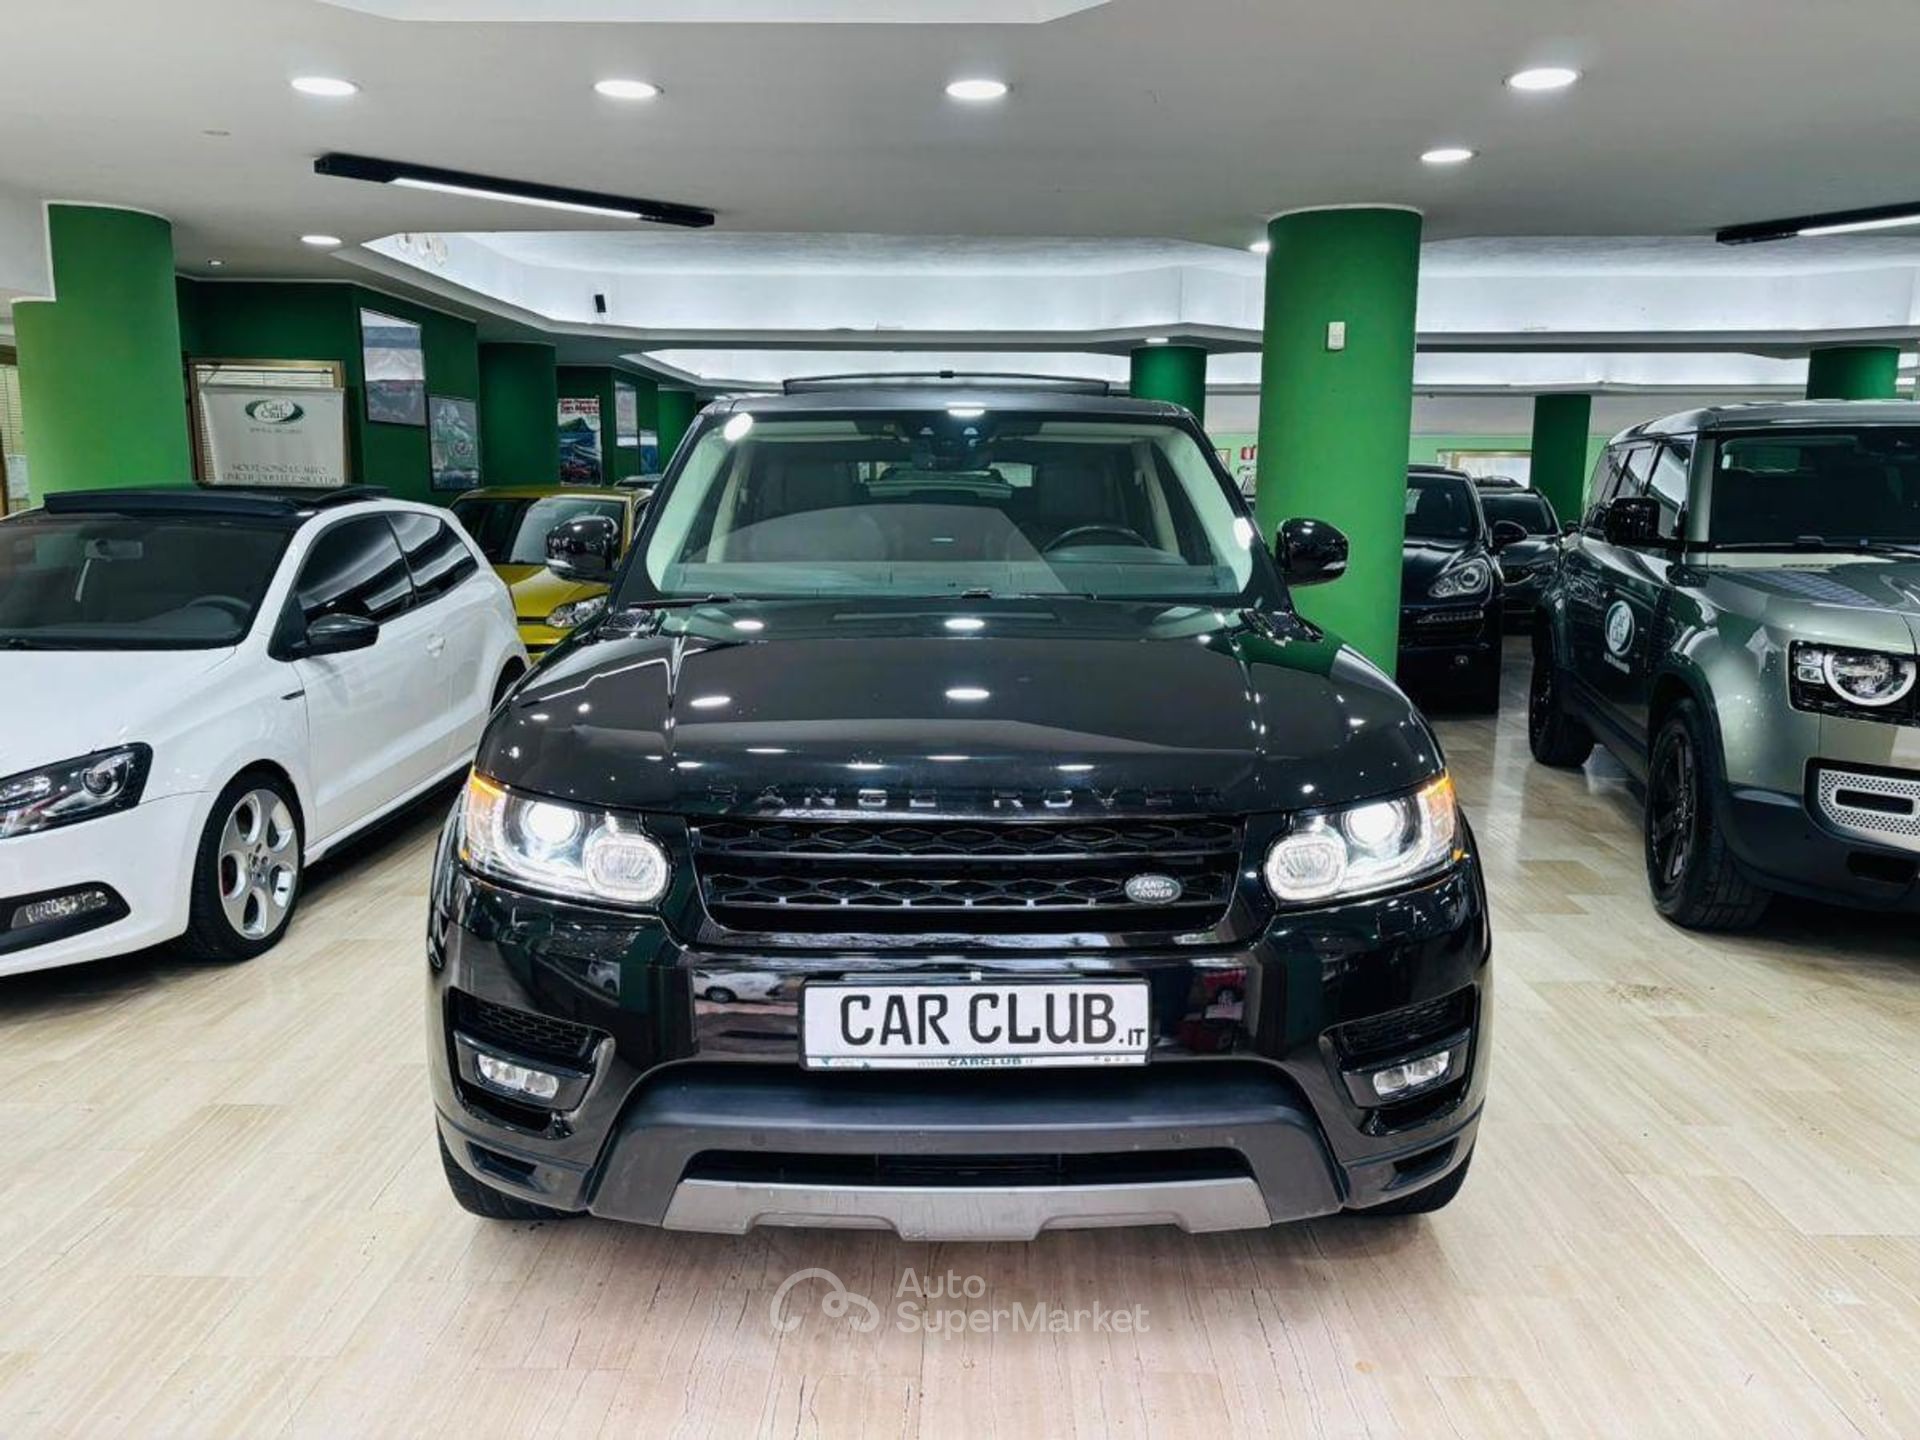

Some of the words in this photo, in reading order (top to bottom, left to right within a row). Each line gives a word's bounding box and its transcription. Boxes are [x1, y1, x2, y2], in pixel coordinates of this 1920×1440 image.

[707, 784, 937, 807] RANGE
[992, 784, 1228, 808] ROVER
[1135, 880, 1164, 889] LAND
[1139, 888, 1173, 898] ROVER
[840, 993, 950, 1046] CAR
